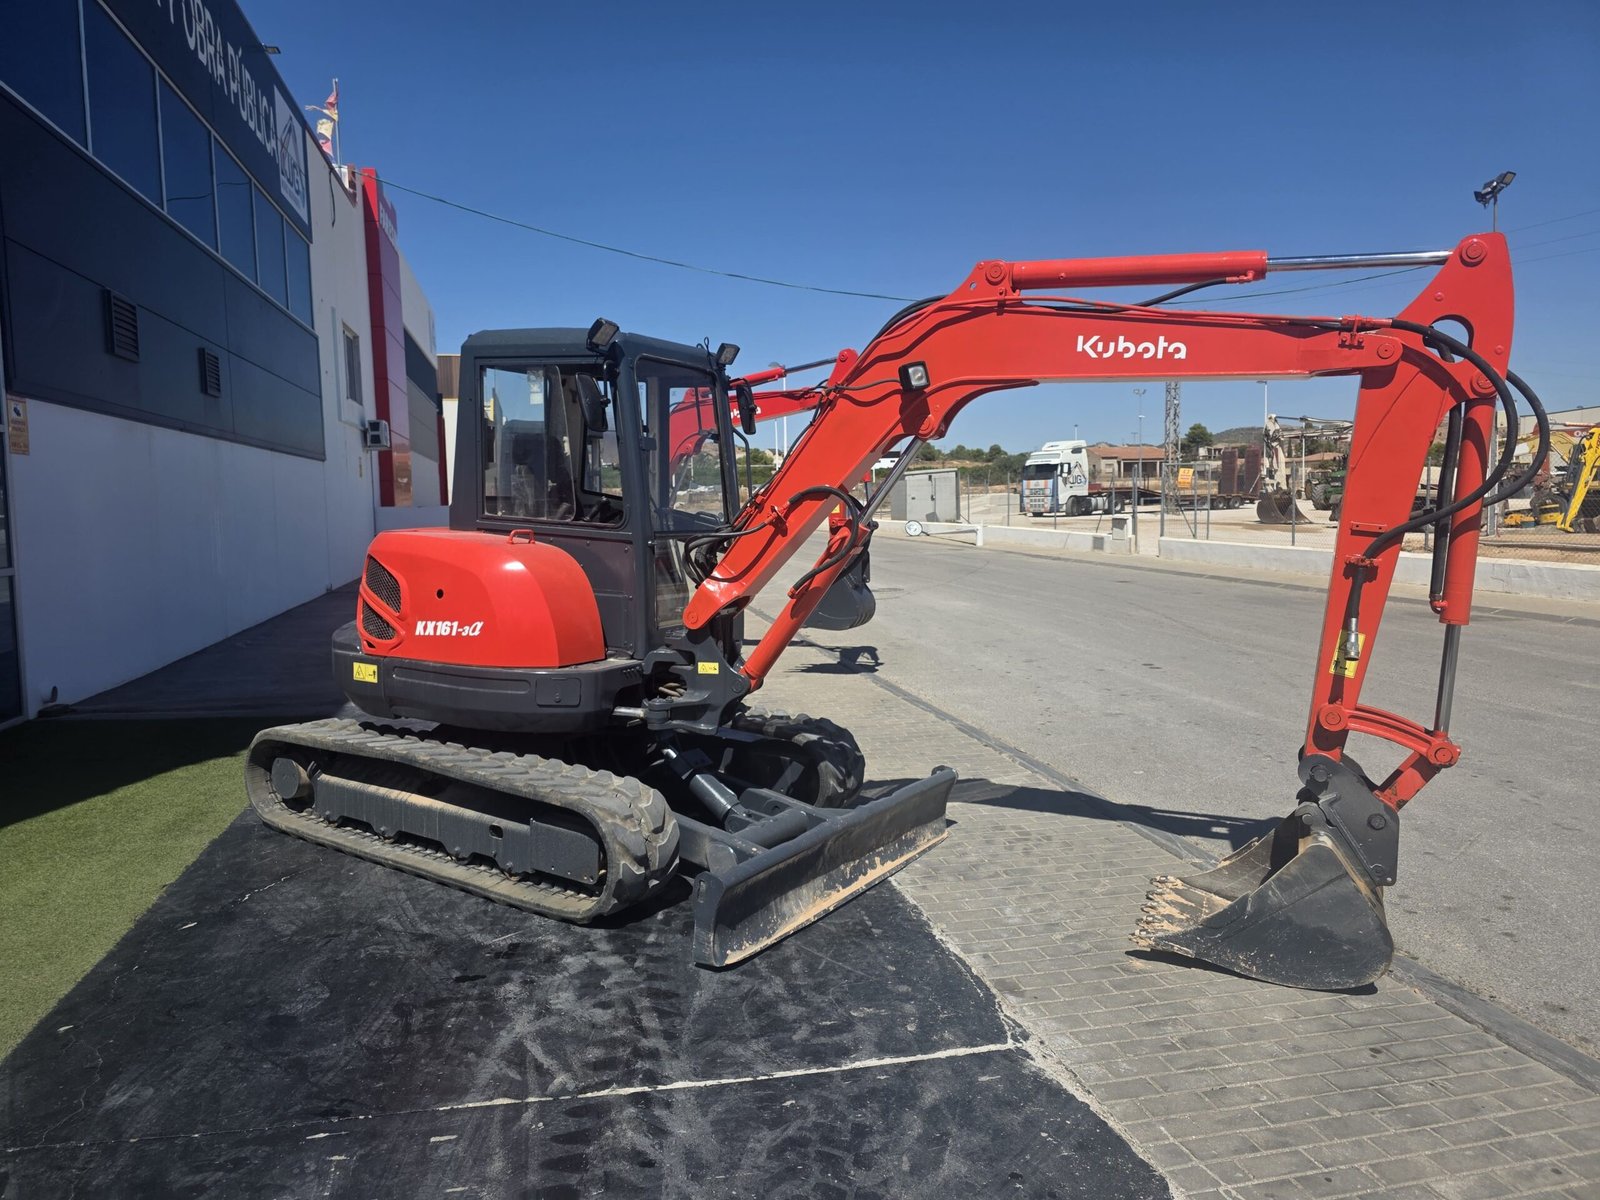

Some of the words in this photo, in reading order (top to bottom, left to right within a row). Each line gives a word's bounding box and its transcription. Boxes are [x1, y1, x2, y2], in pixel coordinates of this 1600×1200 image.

[182, 0, 228, 96] OBRA
[227, 42, 280, 164] PÚBLICA
[1077, 335, 1187, 359] Kubota
